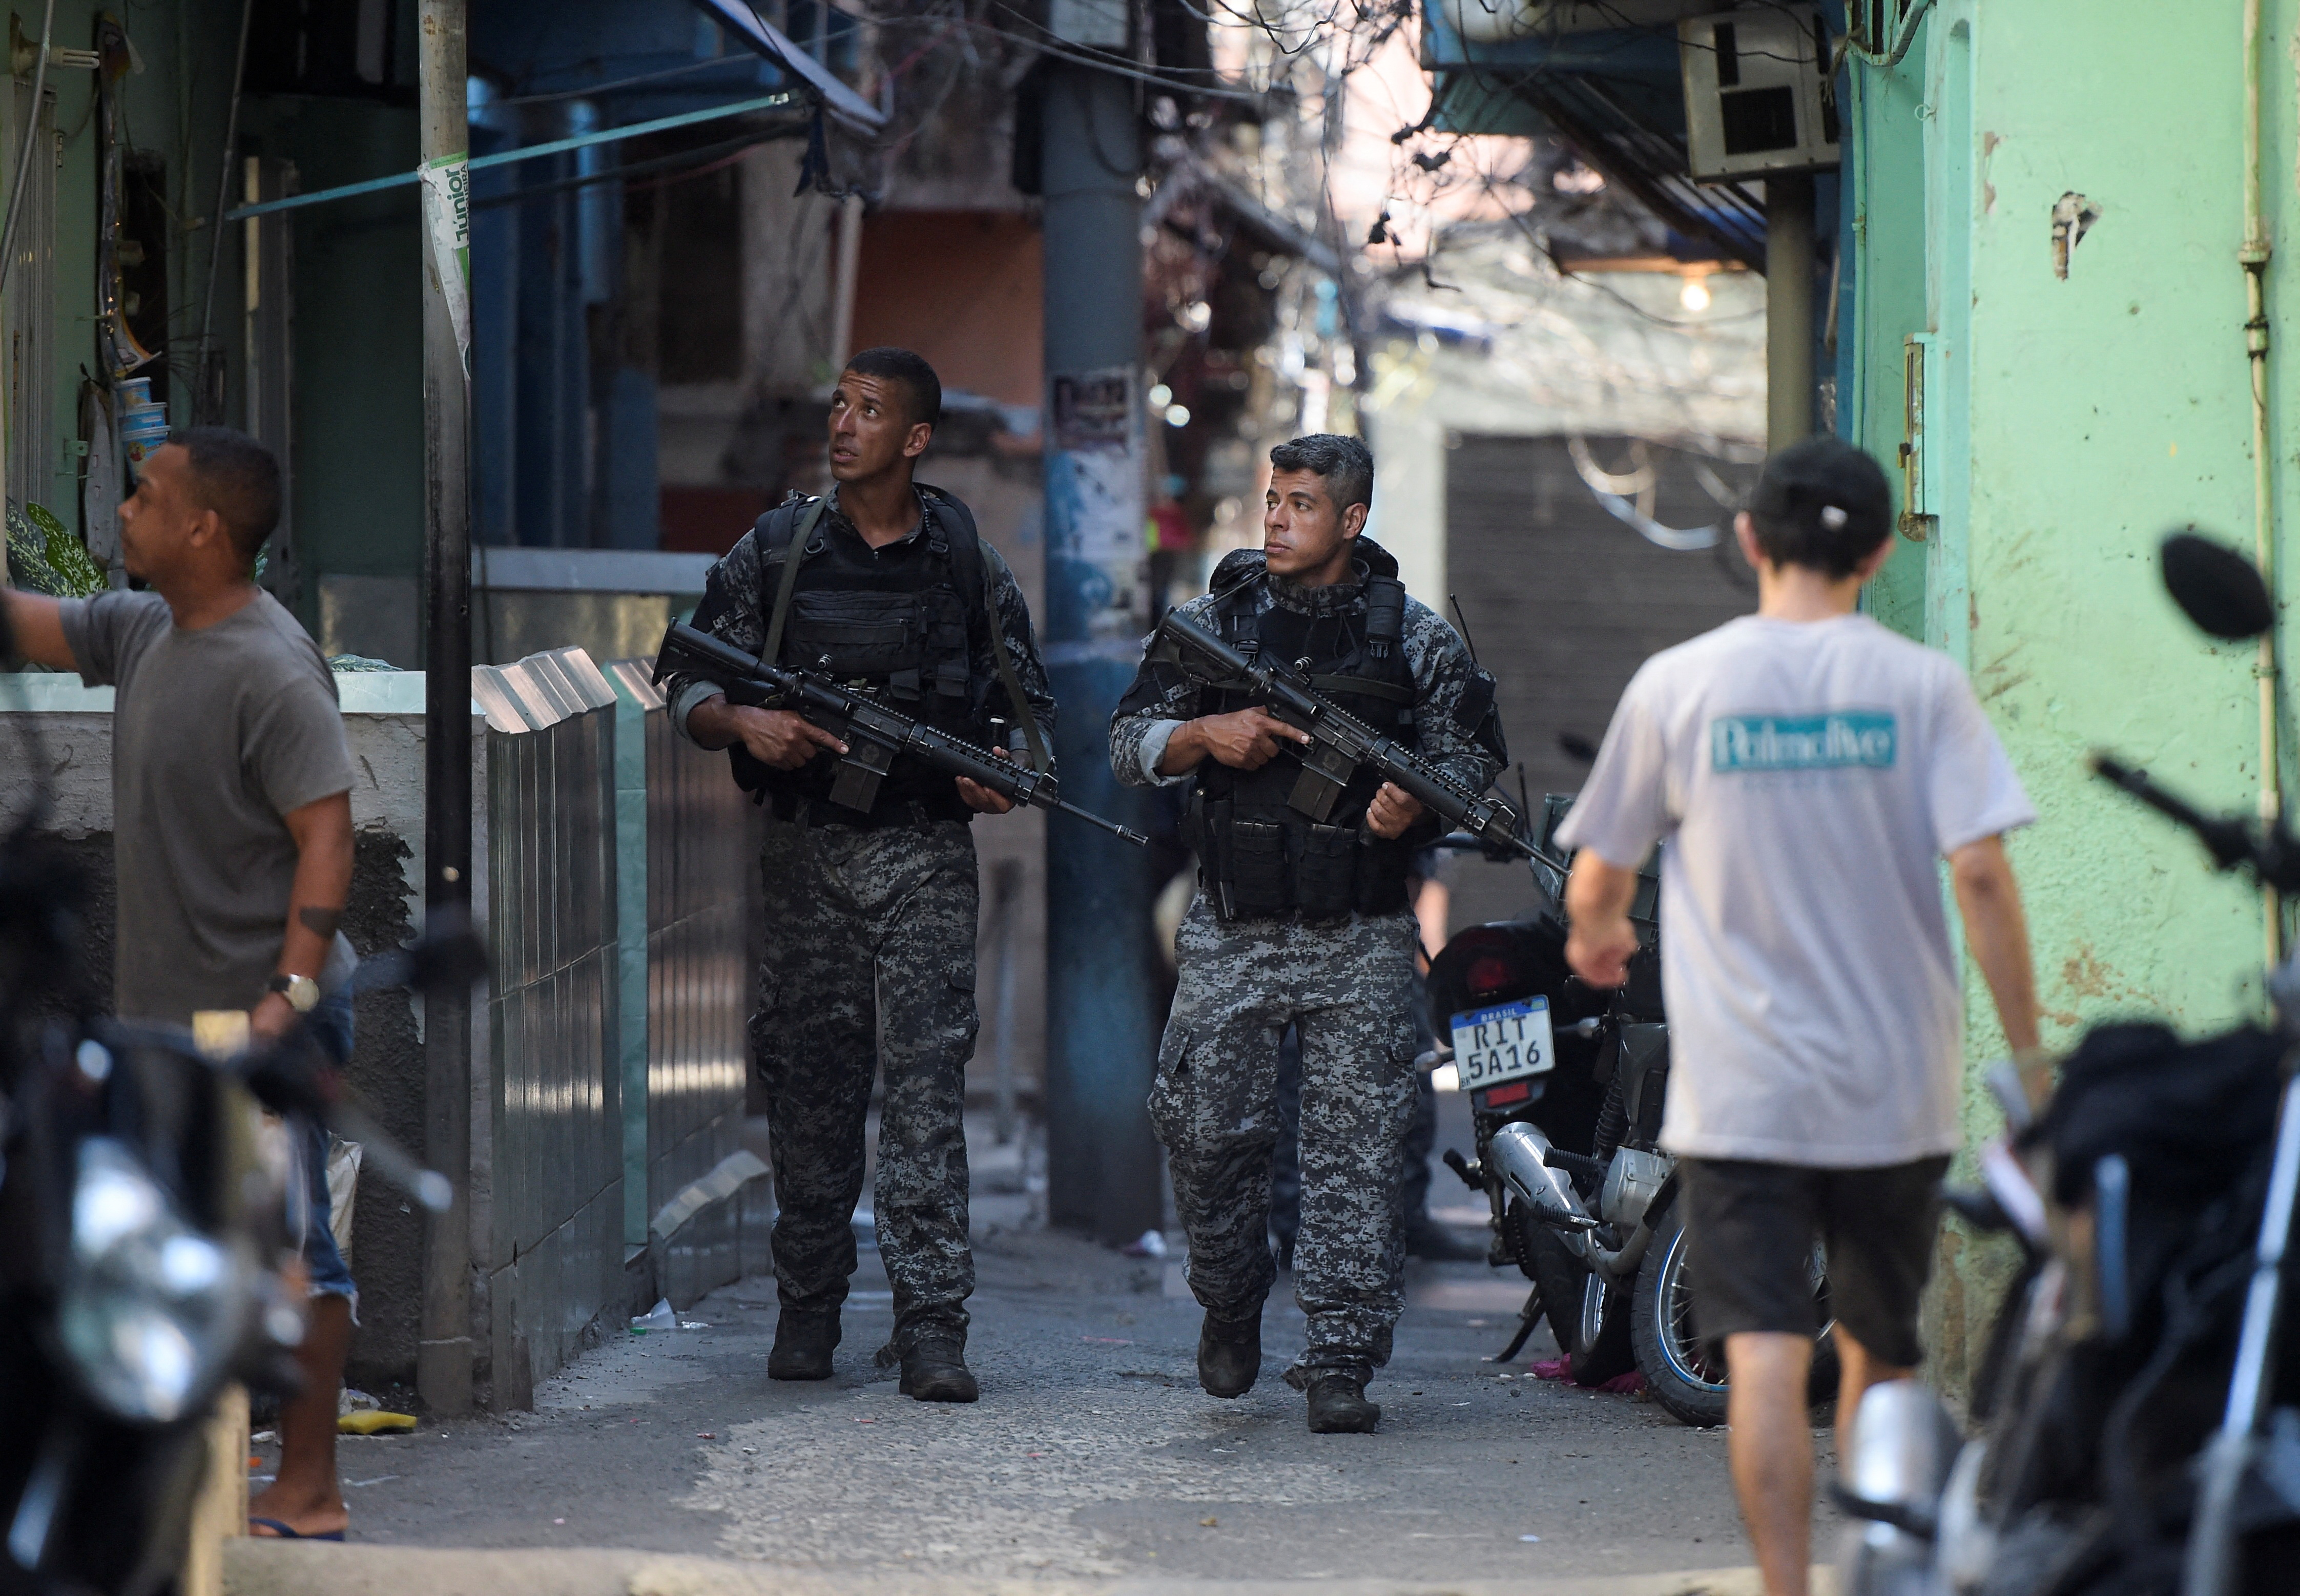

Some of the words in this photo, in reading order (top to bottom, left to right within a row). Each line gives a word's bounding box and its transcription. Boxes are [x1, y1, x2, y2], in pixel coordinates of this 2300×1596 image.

[445, 169, 468, 241] Júnior
[1481, 1008, 1516, 1022] BRASIL
[1474, 1016, 1526, 1050] RIT
[1467, 1041, 1541, 1079] 5A16
[1461, 1077, 1472, 1087] BR
